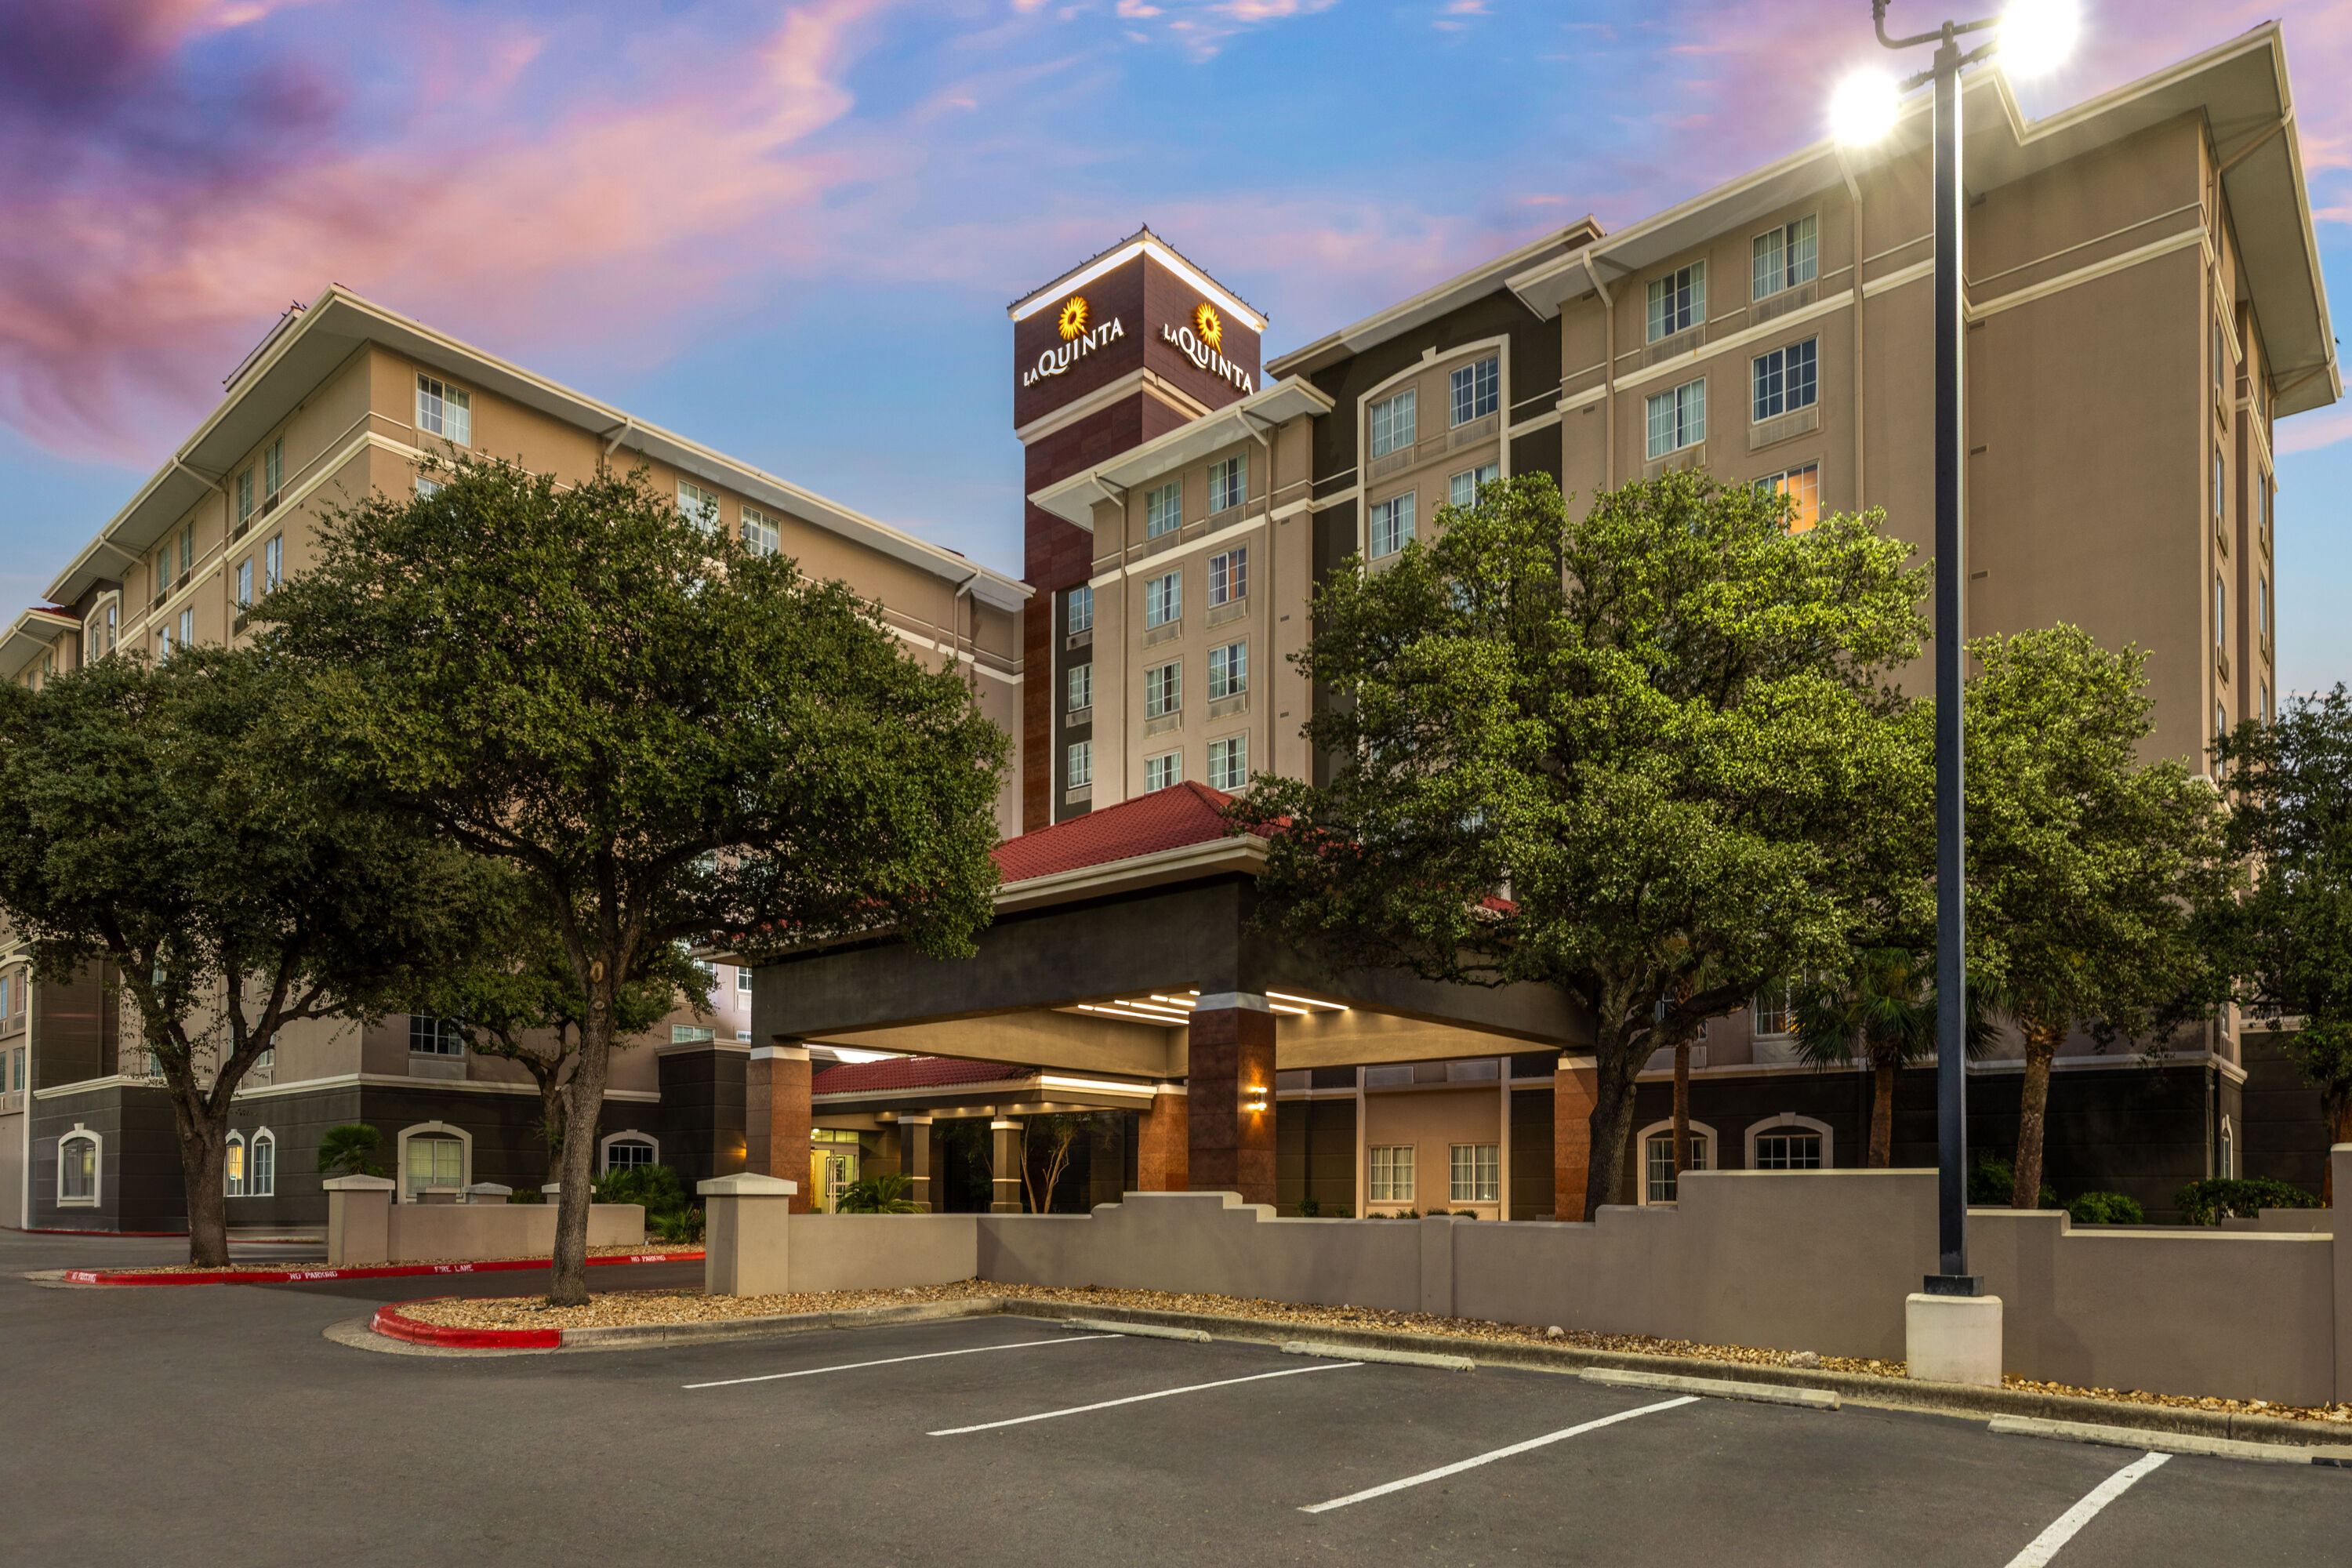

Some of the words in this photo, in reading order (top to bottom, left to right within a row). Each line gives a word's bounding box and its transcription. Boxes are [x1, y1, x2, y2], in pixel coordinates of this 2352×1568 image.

[1023, 367, 1039, 387] LA
[1038, 317, 1124, 376] QUINTA
[1164, 323, 1179, 347] LA
[1178, 326, 1254, 396] QUINTA
[305, 1270, 338, 1279] PARKING
[454, 1264, 474, 1272] LANE
